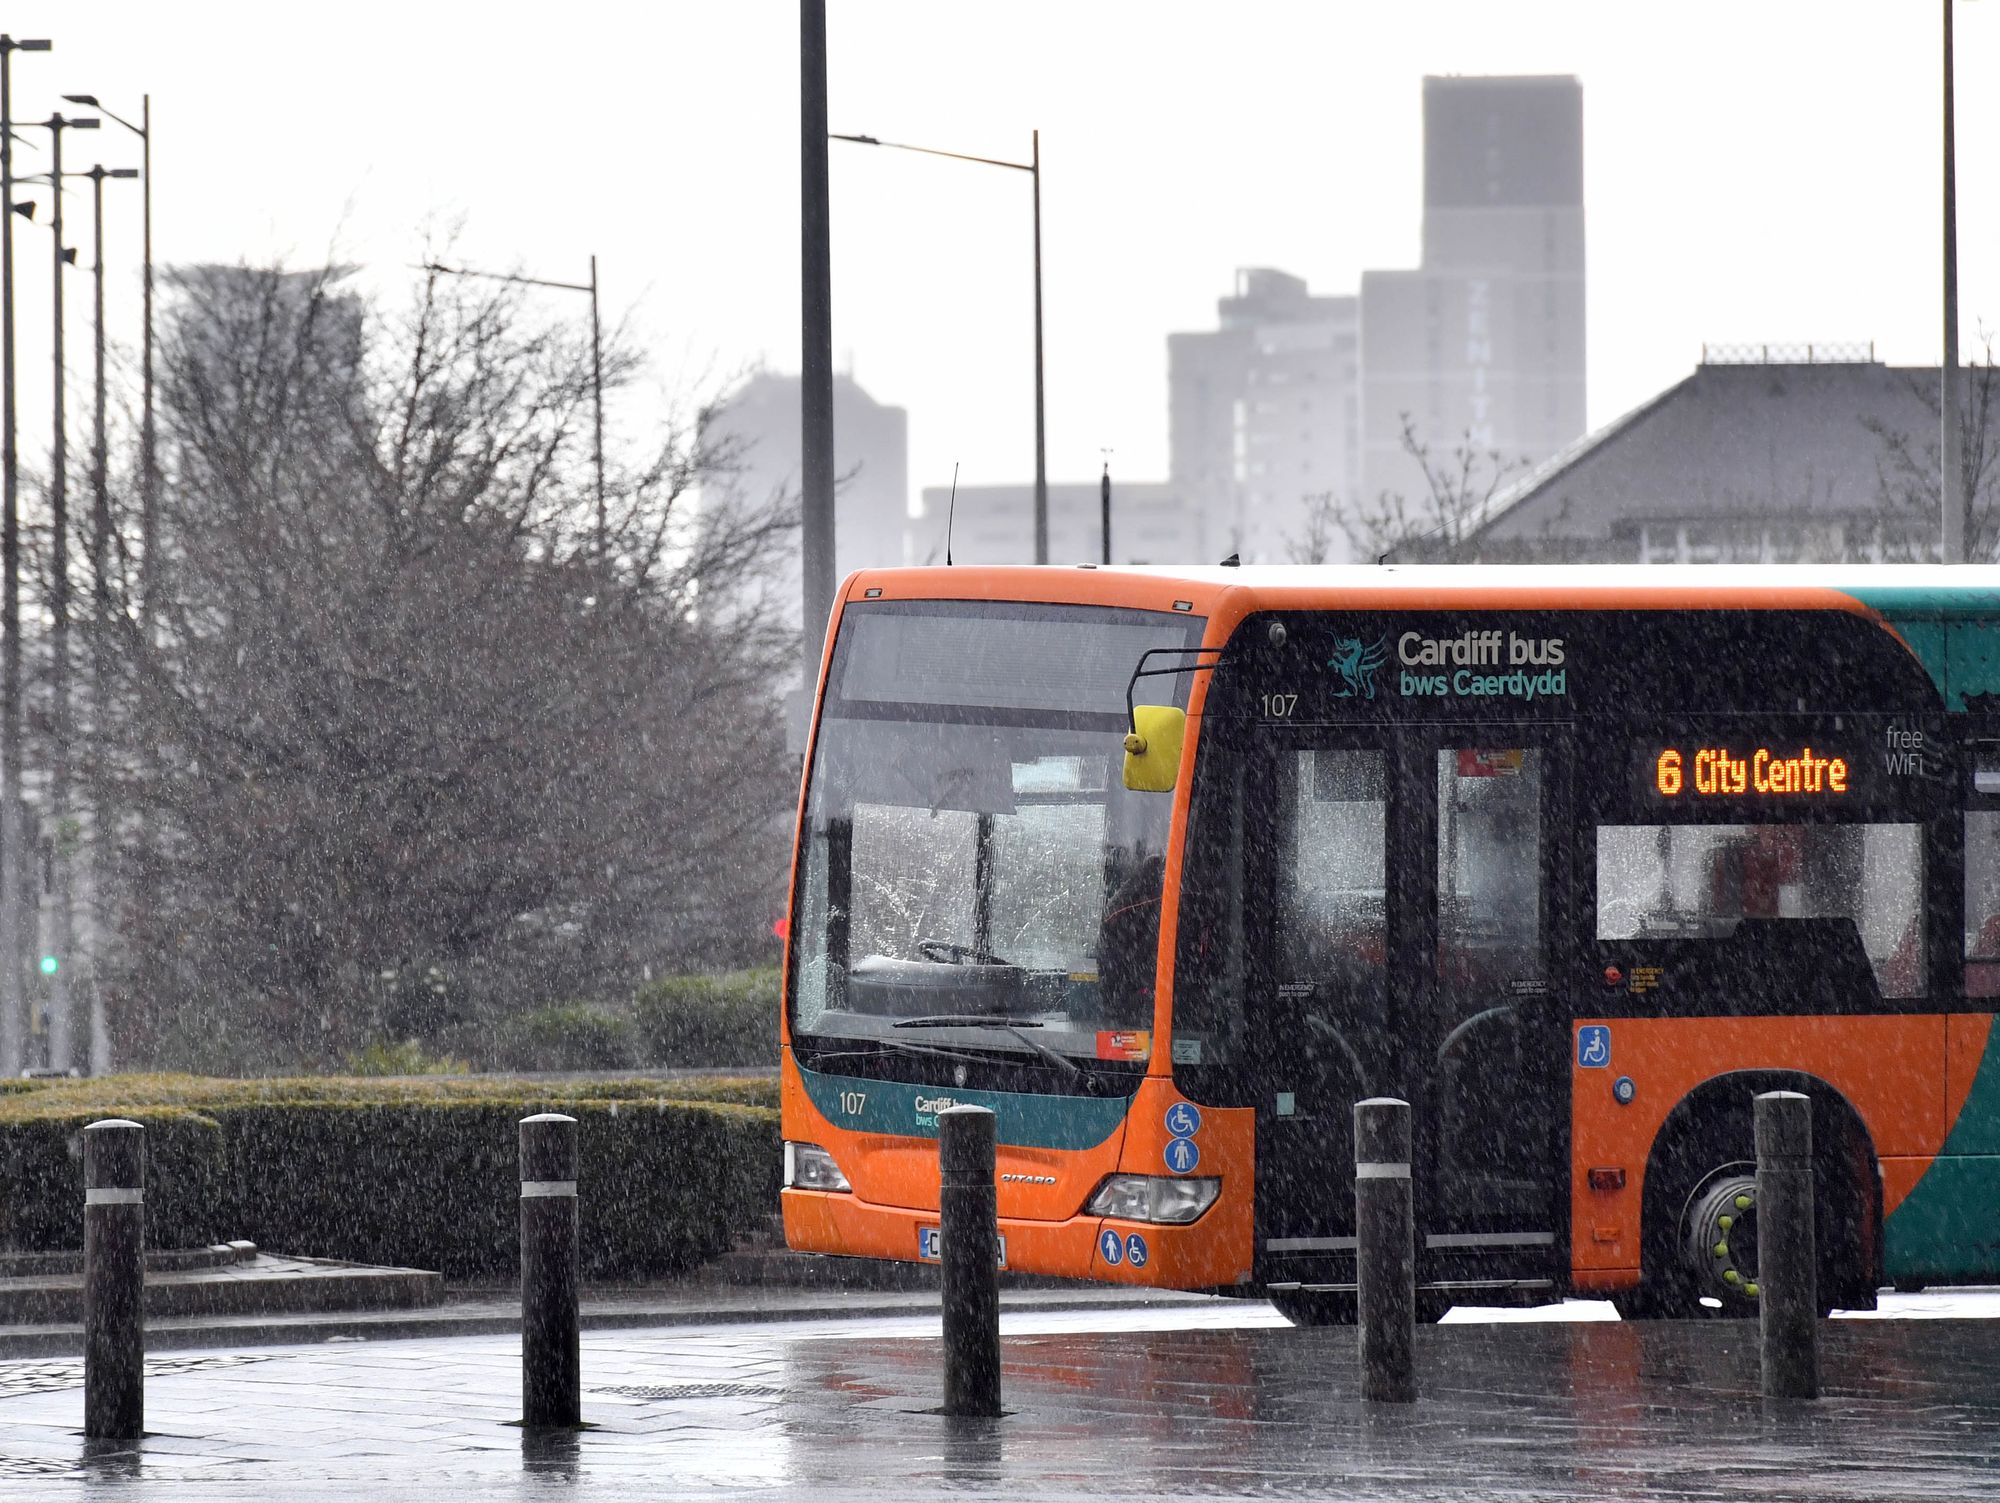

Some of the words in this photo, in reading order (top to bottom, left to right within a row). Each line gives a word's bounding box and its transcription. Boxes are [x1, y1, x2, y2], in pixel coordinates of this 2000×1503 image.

[1399, 631, 1501, 666] Cardiff
[1509, 631, 1565, 666] bus
[1400, 671, 1448, 696] bws
[1453, 669, 1566, 701] Caerdydd
[1261, 694, 1298, 717] 107
[1886, 725, 1923, 749] free
[1657, 749, 1683, 794] 6
[1694, 748, 1747, 793] City
[1752, 747, 1847, 792] Centre
[1885, 753, 1923, 776] WiFi
[840, 1091, 866, 1115] 107
[915, 1095, 952, 1114] Cardiff
[916, 1113, 933, 1126] bws
